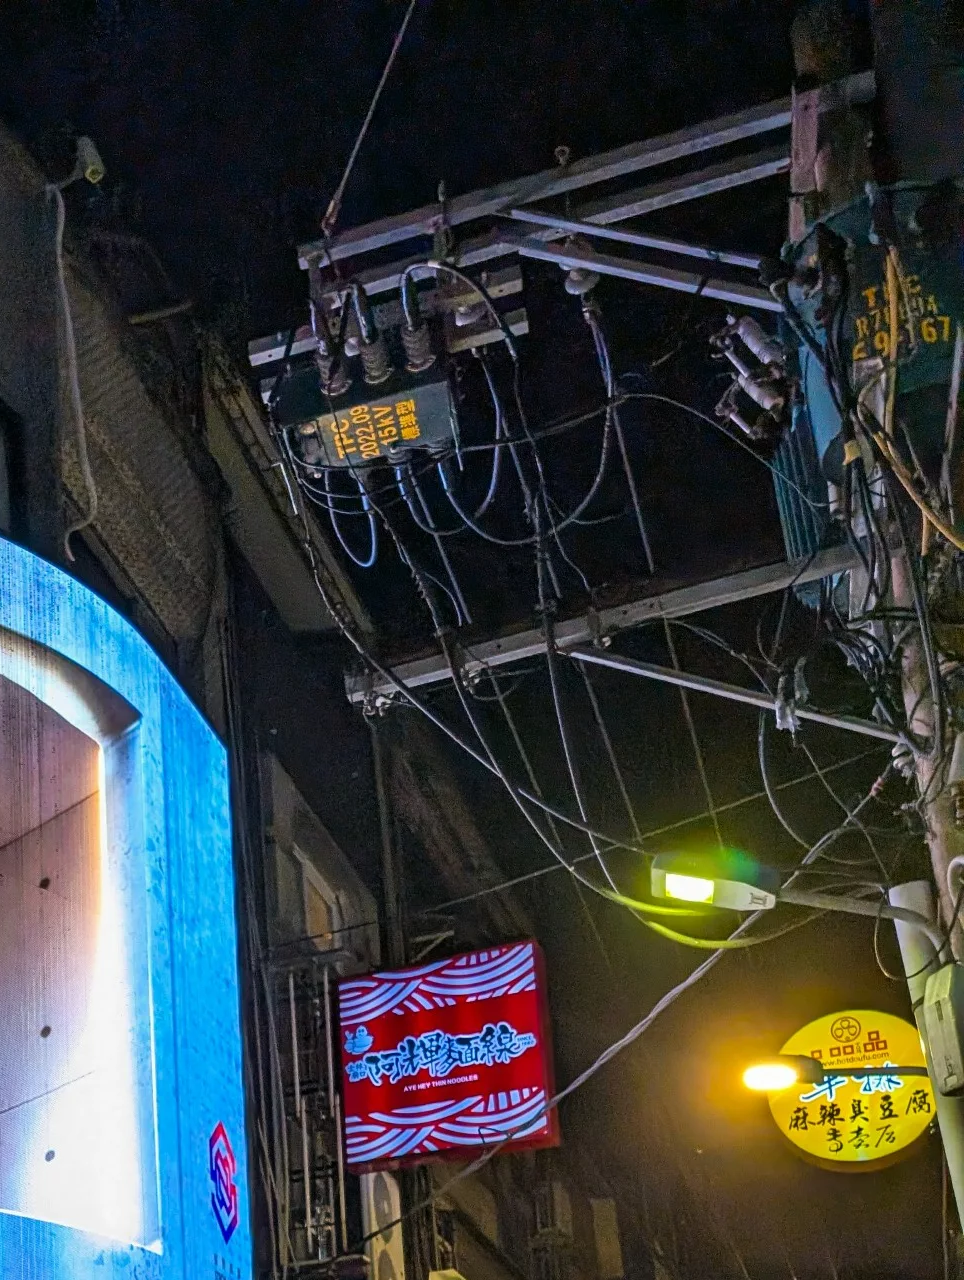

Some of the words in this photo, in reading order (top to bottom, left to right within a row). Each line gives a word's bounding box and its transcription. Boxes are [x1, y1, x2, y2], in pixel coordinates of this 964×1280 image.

[349, 405, 380, 459] 2022.09
[417, 1082, 431, 1090] HEY
[431, 1079, 446, 1088] THIN
[447, 1074, 479, 1085] NOODLES
[788, 1089, 932, 1131] 麻辣臭豆腐
